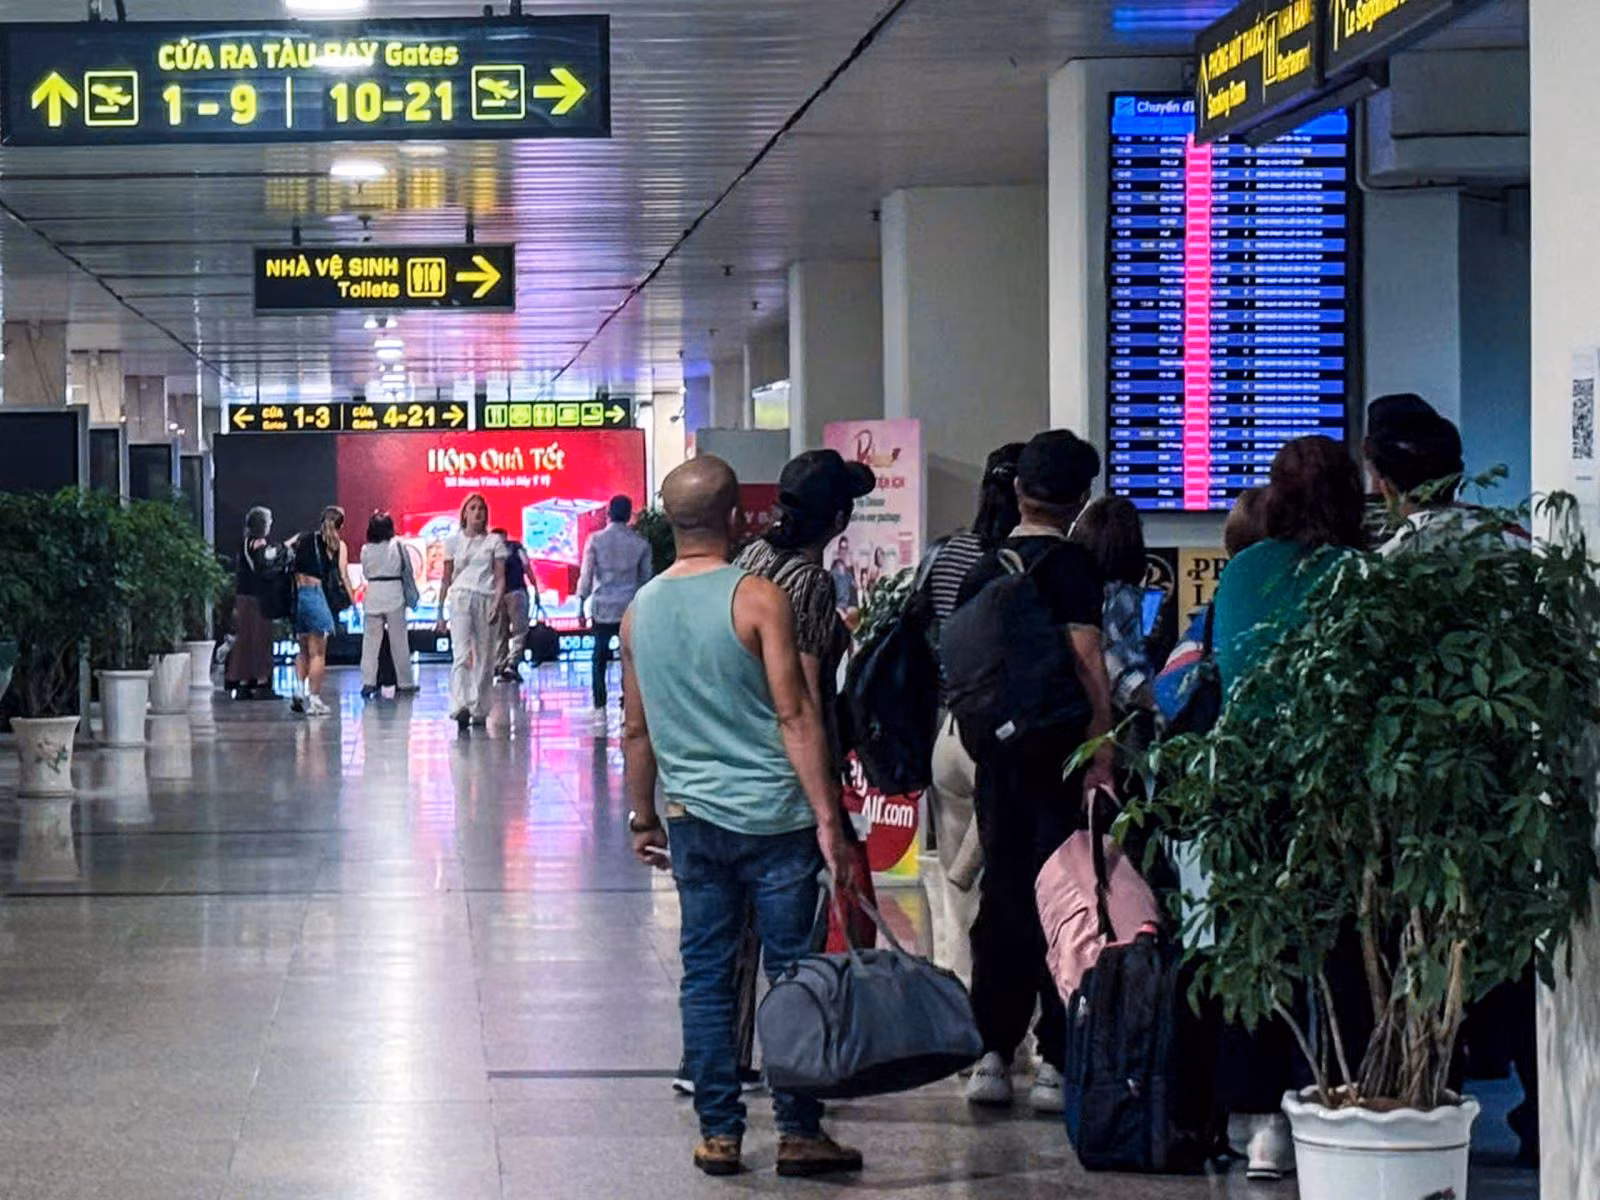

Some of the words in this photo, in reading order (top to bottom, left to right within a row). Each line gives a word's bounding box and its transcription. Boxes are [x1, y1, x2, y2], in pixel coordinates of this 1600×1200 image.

[158, 37, 215, 70] CỬA
[220, 44, 258, 70] RA
[262, 37, 313, 69] TÀU
[385, 42, 460, 67] Gates
[330, 80, 454, 123] 10-21
[266, 254, 311, 277] NHÀ
[315, 254, 344, 280] VỆ
[349, 258, 399, 276] SINH
[338, 281, 400, 298] Toilets
[293, 406, 331, 429] 1-3
[383, 404, 436, 428] 4-21
